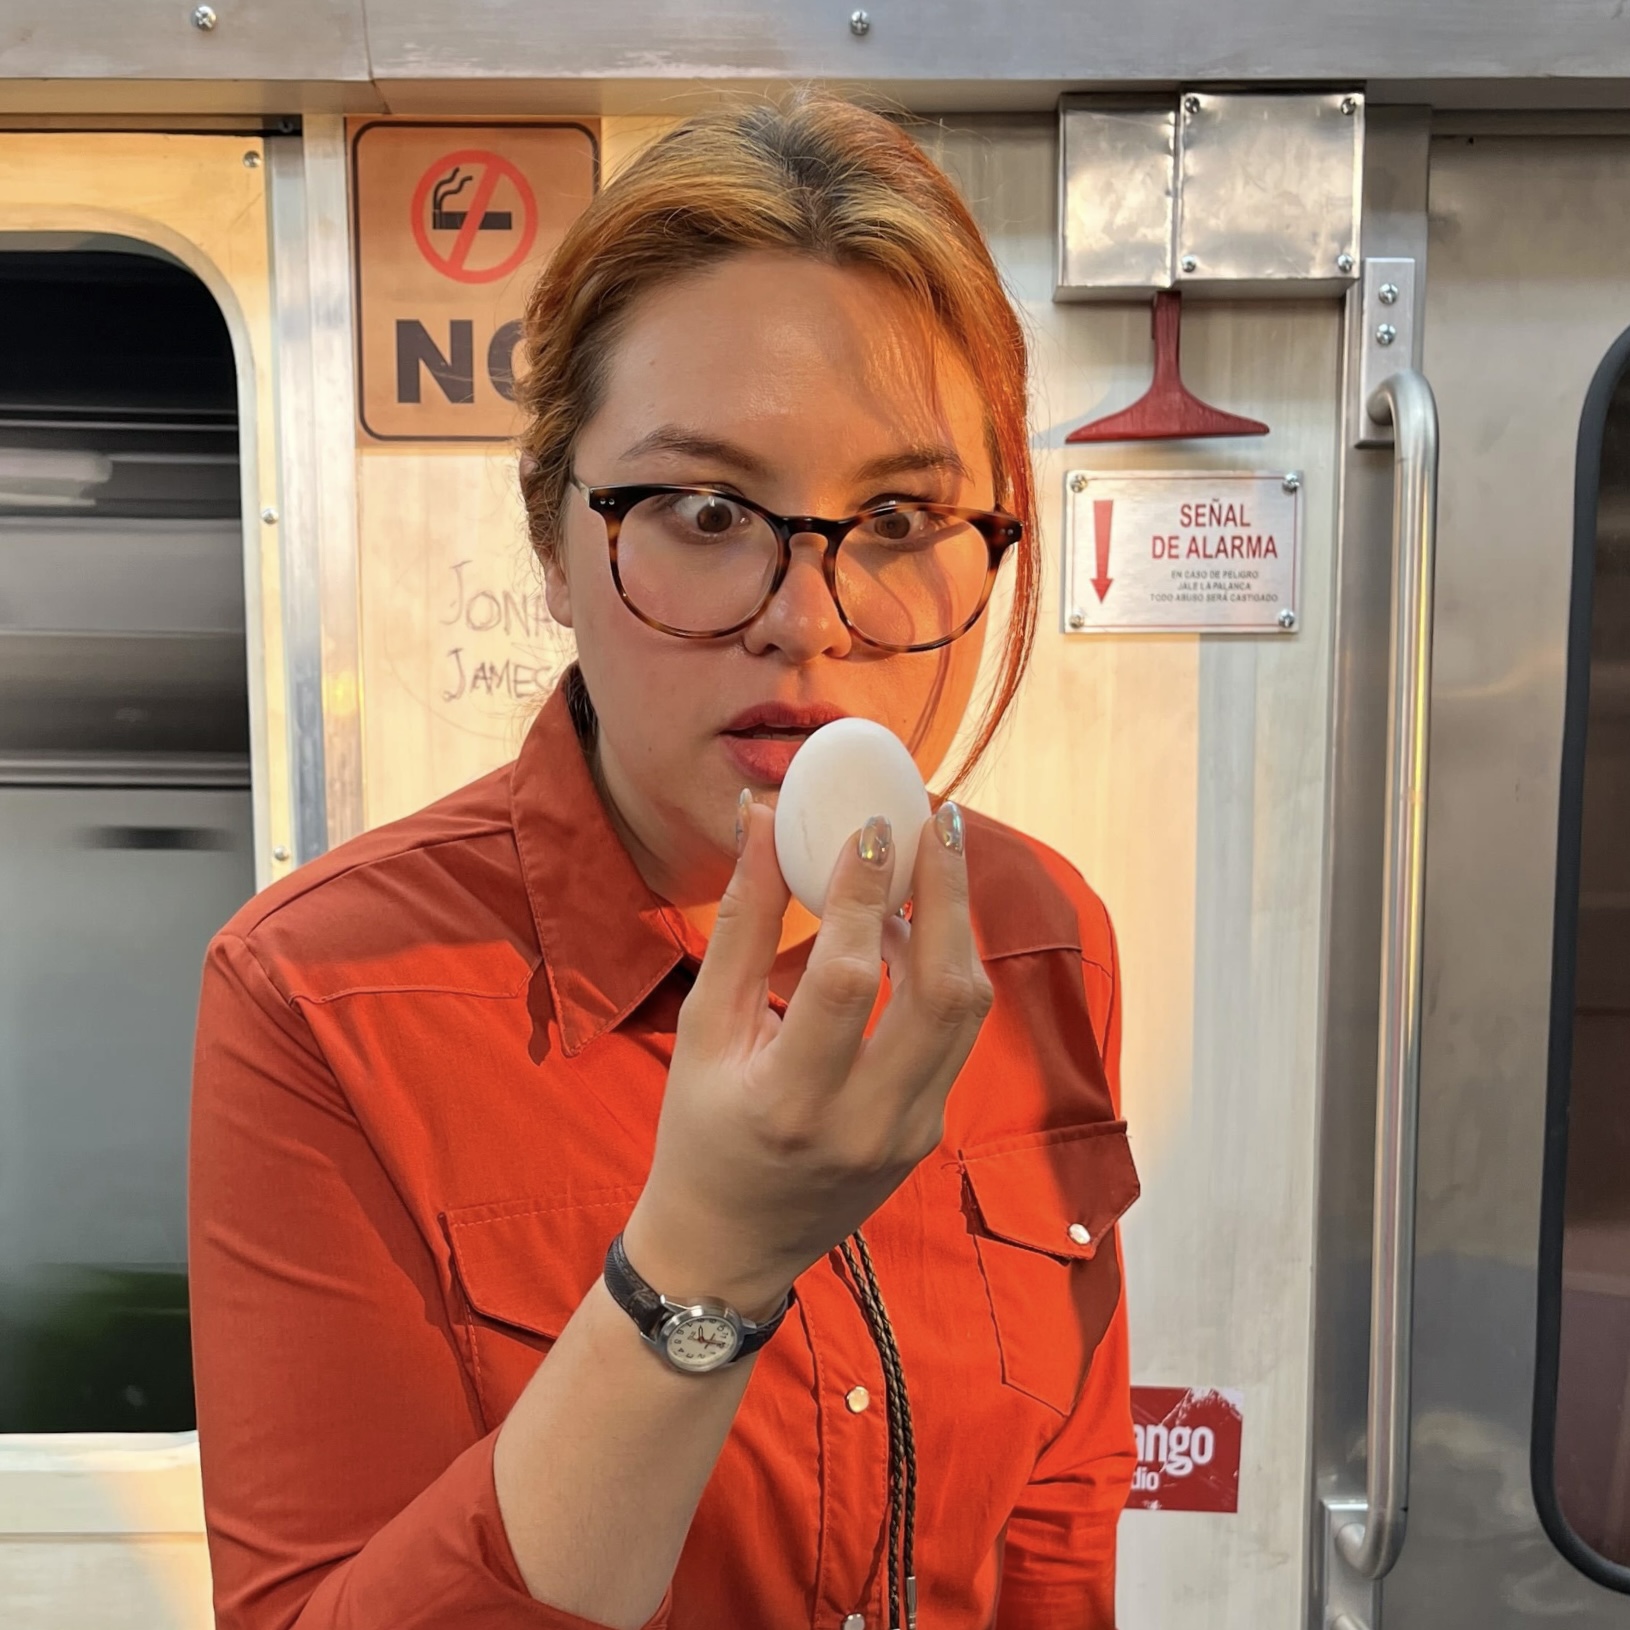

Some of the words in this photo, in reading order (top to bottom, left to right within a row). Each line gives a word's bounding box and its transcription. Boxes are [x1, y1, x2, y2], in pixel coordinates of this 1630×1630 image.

[1180, 498, 1251, 528] SEÑAL
[1152, 535, 1180, 559] DE
[1186, 535, 1278, 559] ALARMA
[1171, 570, 1182, 579] EN
[1184, 570, 1207, 579] CASO
[1209, 570, 1220, 579] DE
[1223, 570, 1259, 579] PELIGRO
[1177, 581, 1198, 590] JALE
[1200, 581, 1212, 590] LA
[1213, 581, 1251, 590] PALANCA
[1151, 593, 1173, 602] TODO
[1176, 593, 1204, 602] ABUSO
[1230, 593, 1278, 602] CASTIGADO
